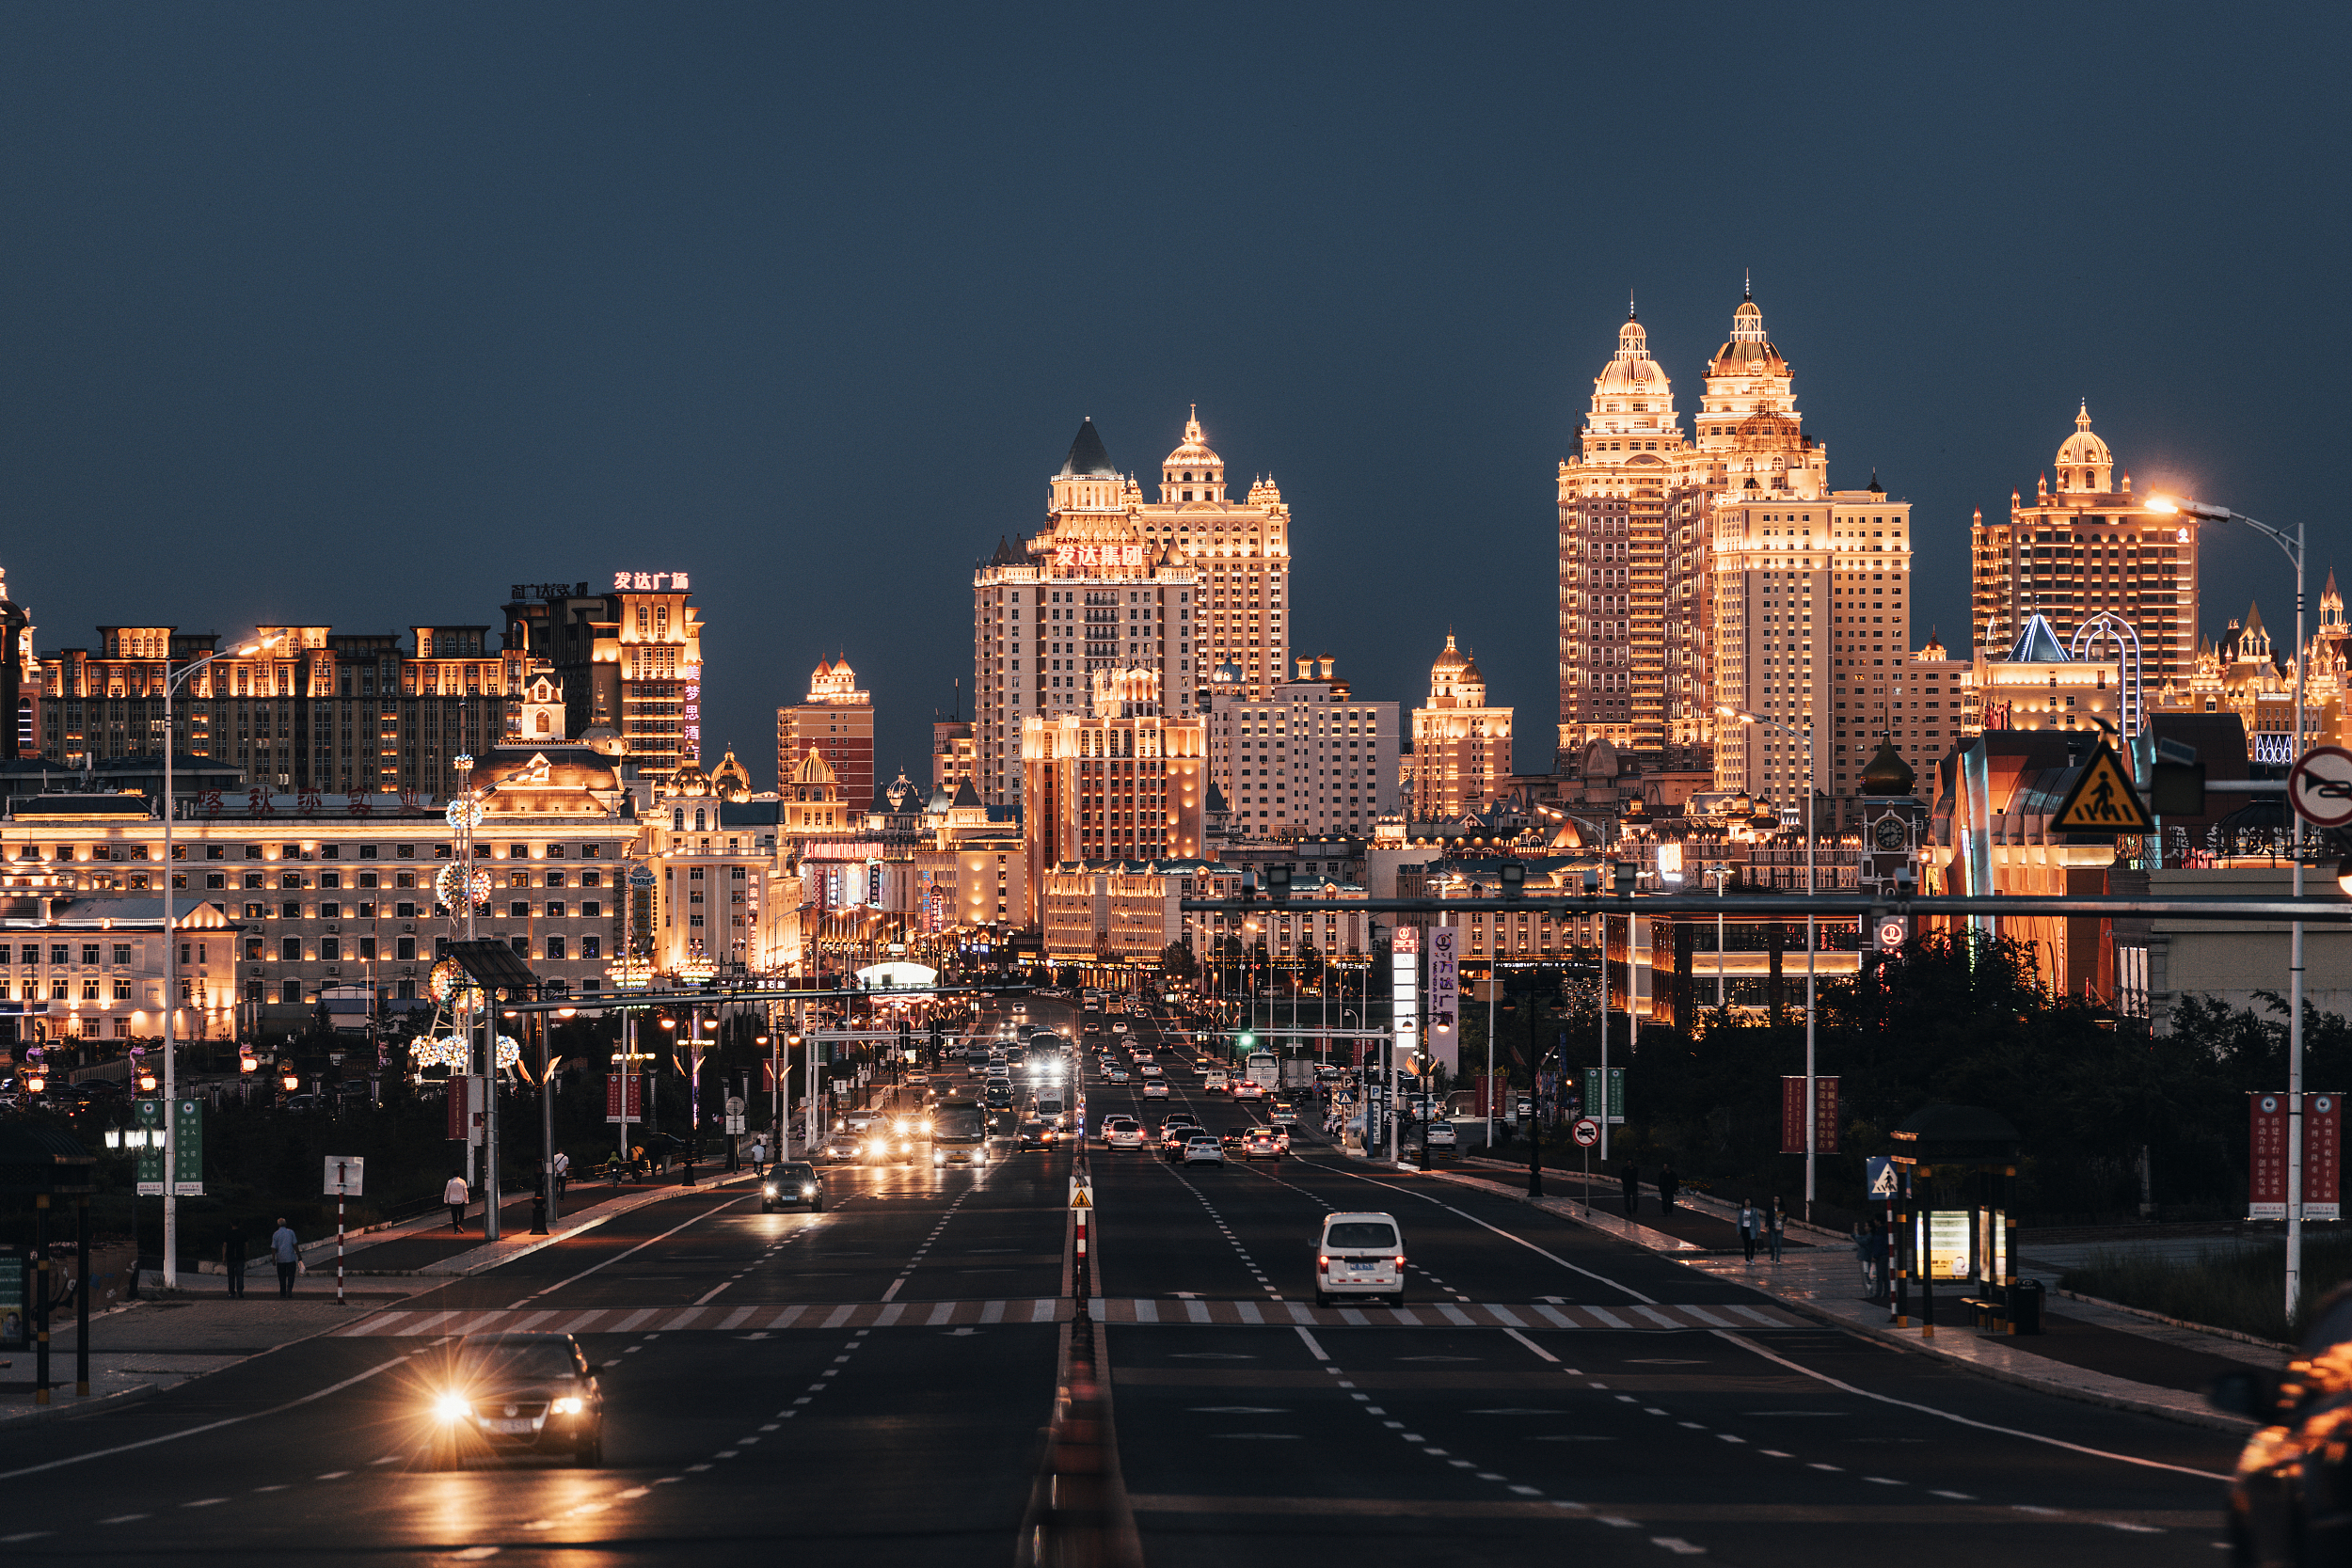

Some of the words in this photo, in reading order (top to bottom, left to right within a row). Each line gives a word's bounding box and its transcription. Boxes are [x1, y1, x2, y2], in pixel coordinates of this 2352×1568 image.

[1056, 546, 1143, 566] 发达集团
[614, 572, 690, 591] 发达广场
[199, 786, 423, 815] 喀秋莎实业
[1345, 1078, 1351, 1086] P
[1373, 1087, 1379, 1096] P
[2311, 1117, 2319, 1198] 北博会隆重开幕
[2324, 1117, 2332, 1198] 热烈庆祝第十五届
